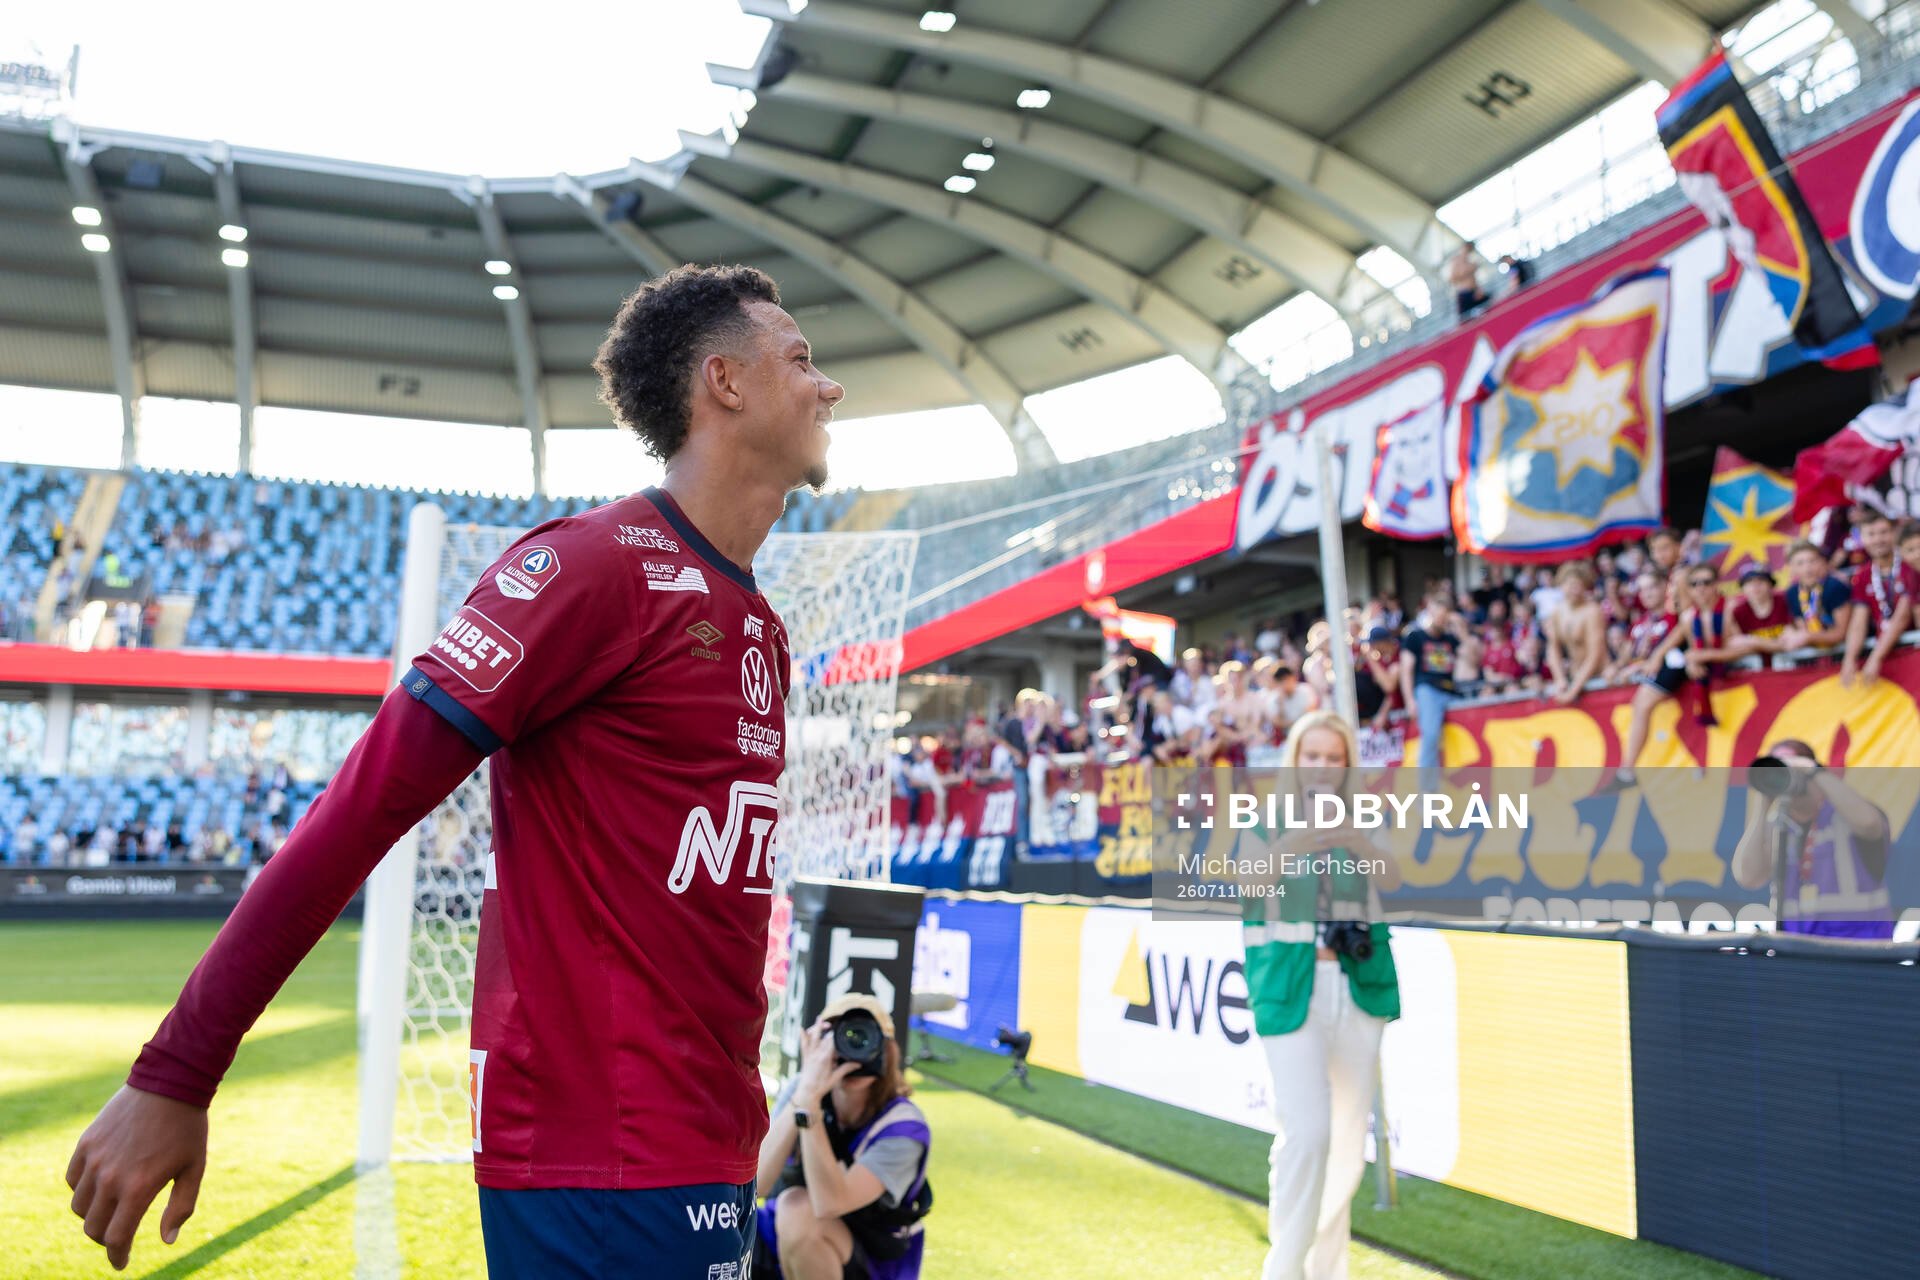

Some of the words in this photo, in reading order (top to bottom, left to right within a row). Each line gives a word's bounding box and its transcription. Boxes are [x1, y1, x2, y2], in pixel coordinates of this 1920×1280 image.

[1463, 70, 1533, 118] H3
[379, 374, 421, 398] F2
[613, 534, 679, 553] WELLNESS
[618, 525, 665, 539] NORDIC
[502, 579, 523, 594] UNIBET
[504, 566, 540, 590] ALLSVENSKAN
[438, 616, 513, 668] NIBET
[691, 647, 721, 661] umbro
[737, 717, 781, 750] factoring
